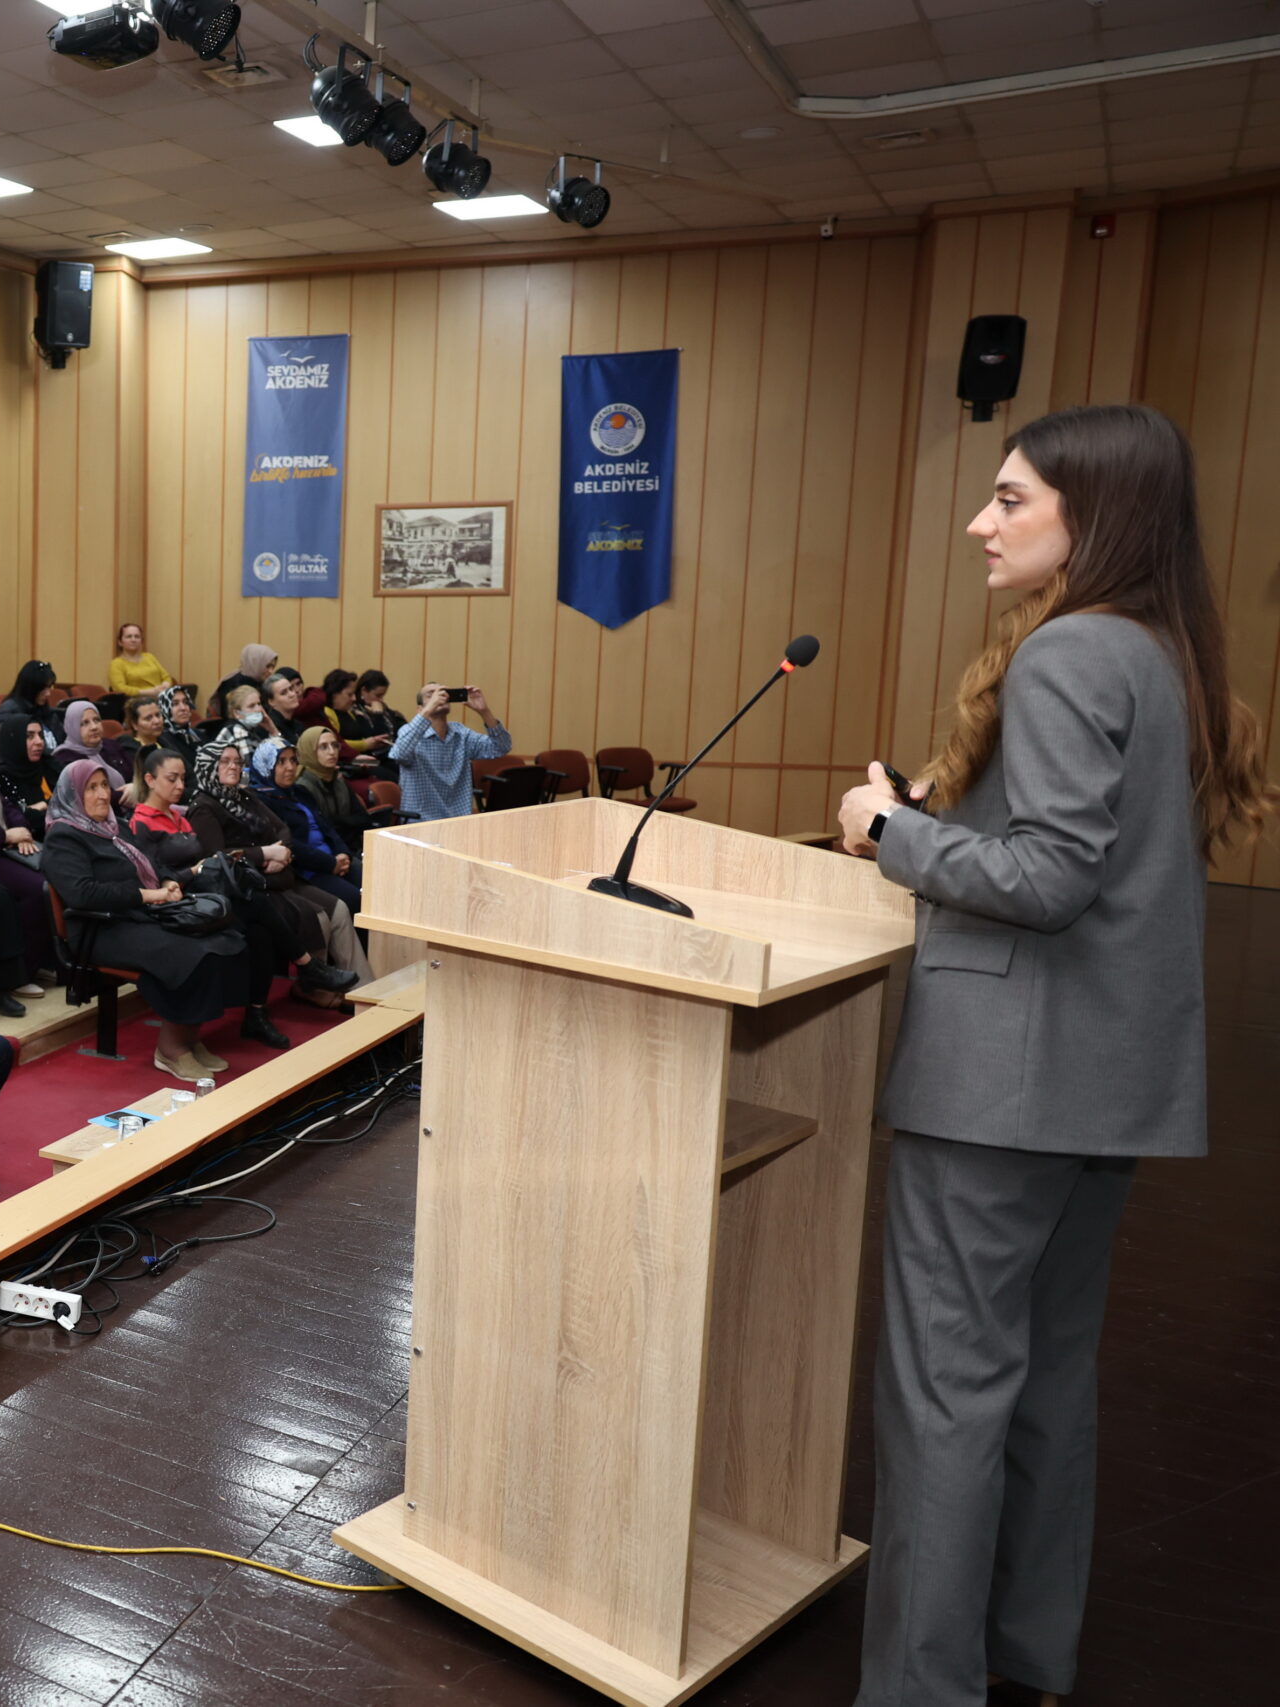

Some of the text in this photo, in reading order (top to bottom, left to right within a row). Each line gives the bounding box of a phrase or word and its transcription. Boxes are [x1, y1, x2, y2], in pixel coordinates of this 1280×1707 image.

[267, 364, 329, 376] SEVDAMIZ
[265, 375, 328, 390] AKDENİZ
[261, 455, 329, 468] AKDENİZ
[584, 459, 649, 477] AKDENİZ
[574, 476, 659, 494] BELEDİYESİ
